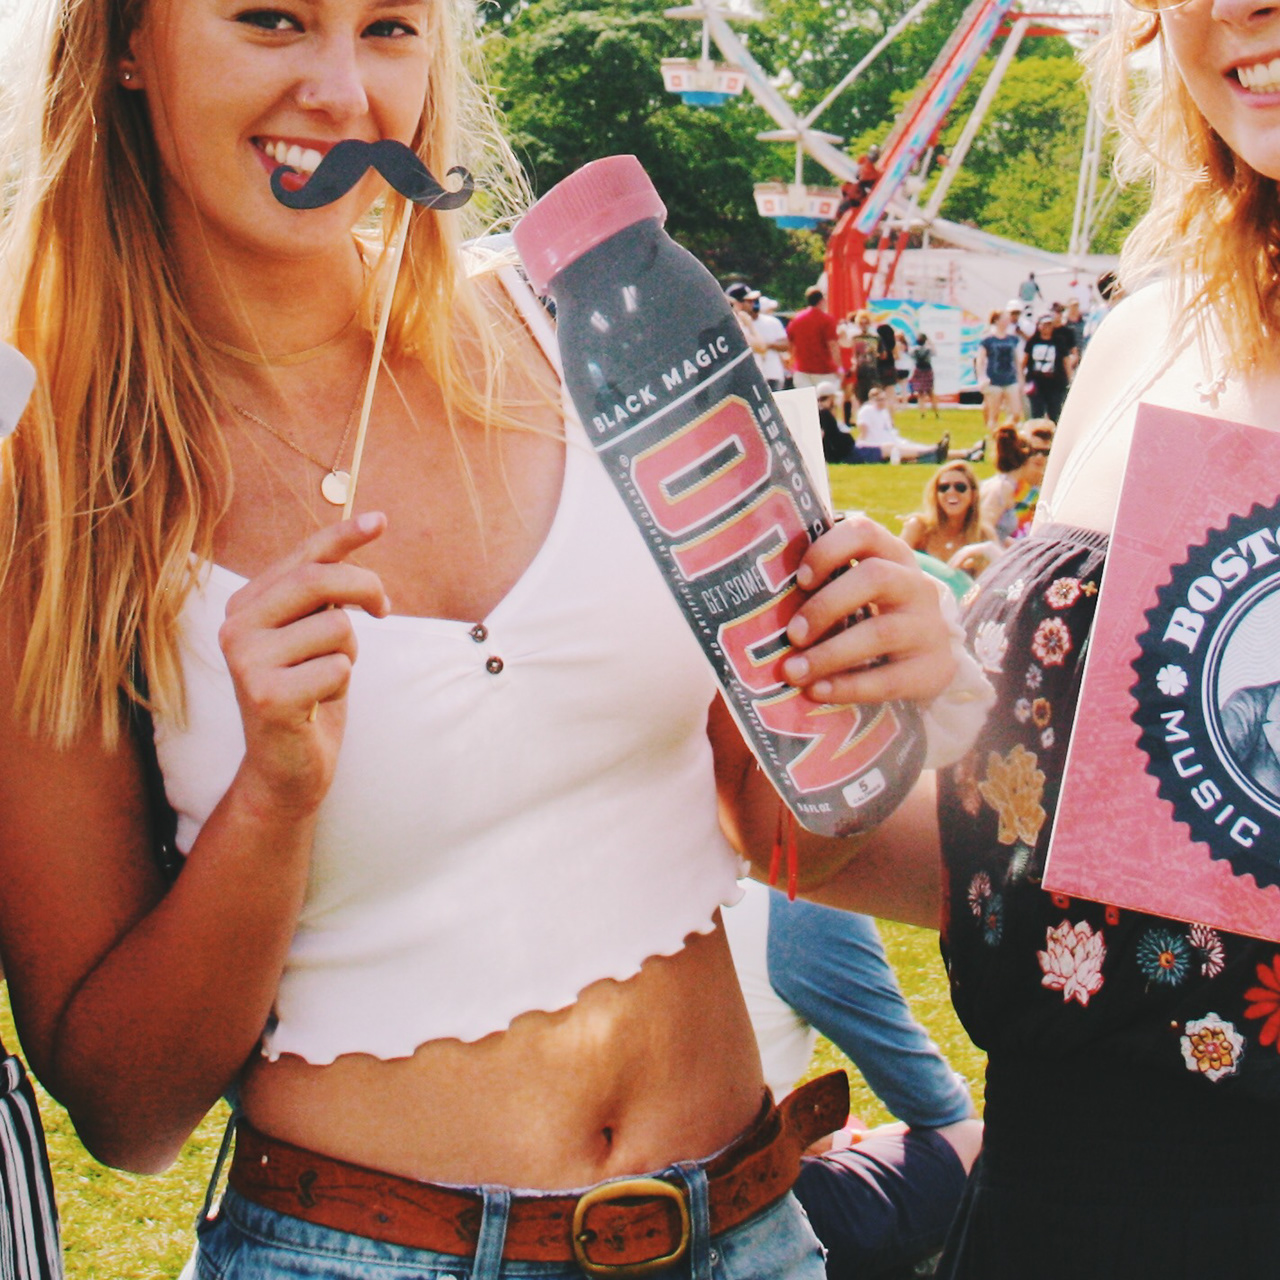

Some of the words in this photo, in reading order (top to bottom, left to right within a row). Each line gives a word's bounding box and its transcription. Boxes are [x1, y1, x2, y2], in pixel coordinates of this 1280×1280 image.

[592, 384, 658, 433] BLACK
[661, 335, 730, 392] MAGIC
[757, 402, 813, 512] COFFEE
[701, 584, 729, 615] GET
[724, 565, 767, 607] SOME
[858, 780, 869, 793] 5
[1160, 709, 1261, 848] MUSIC
